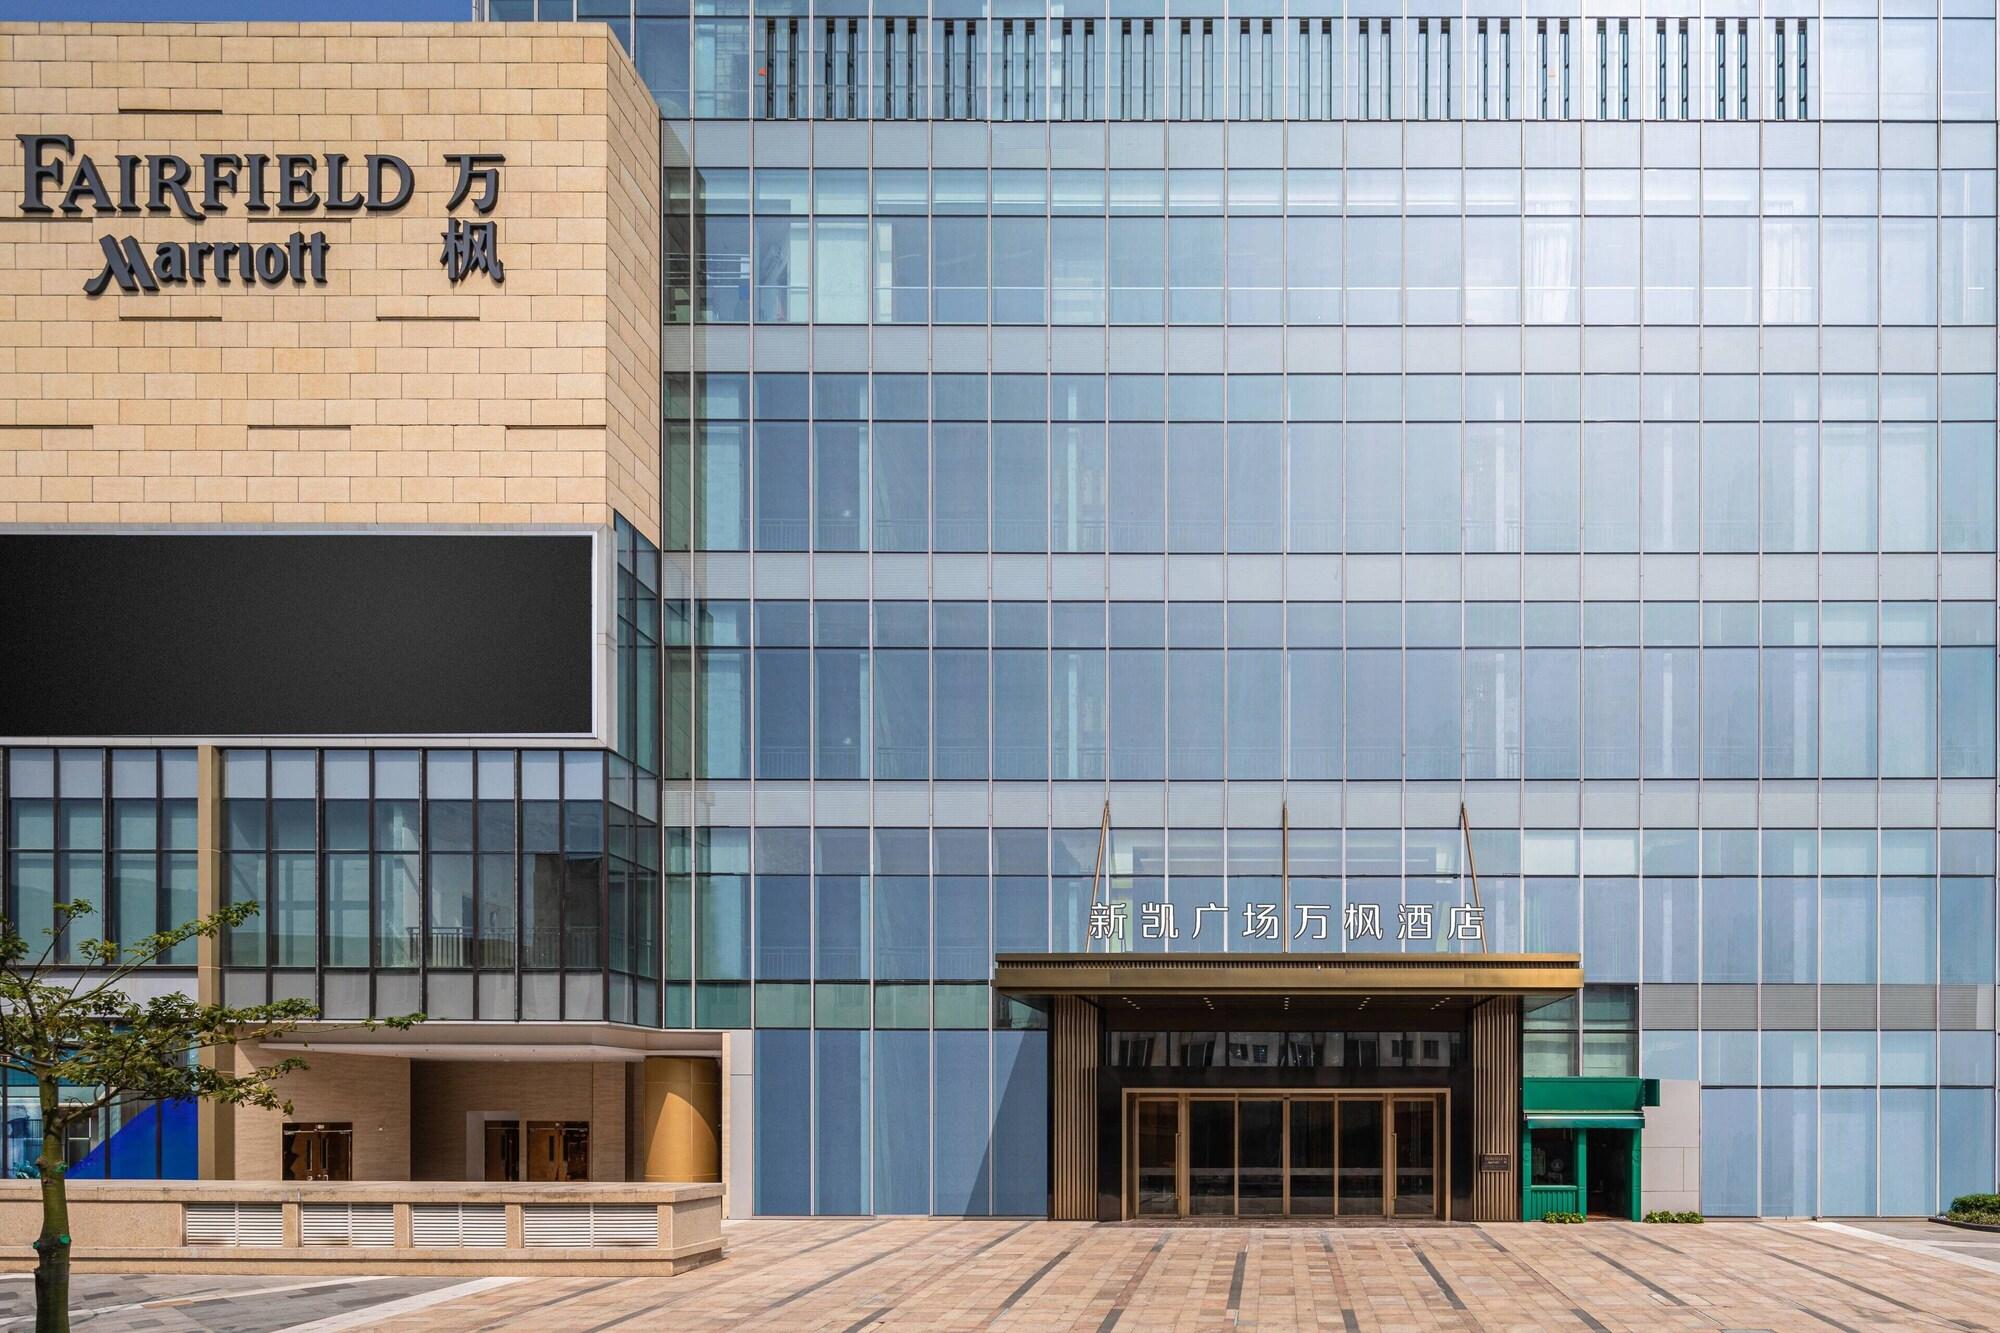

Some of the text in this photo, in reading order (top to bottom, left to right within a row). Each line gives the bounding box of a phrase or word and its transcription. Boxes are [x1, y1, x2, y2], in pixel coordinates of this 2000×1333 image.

[16, 134, 415, 220] FAIRFIELD
[440, 153, 505, 284] 万枫
[83, 231, 330, 296] Marriott
[1089, 902, 1486, 940] 新凯广场万枫酒店
